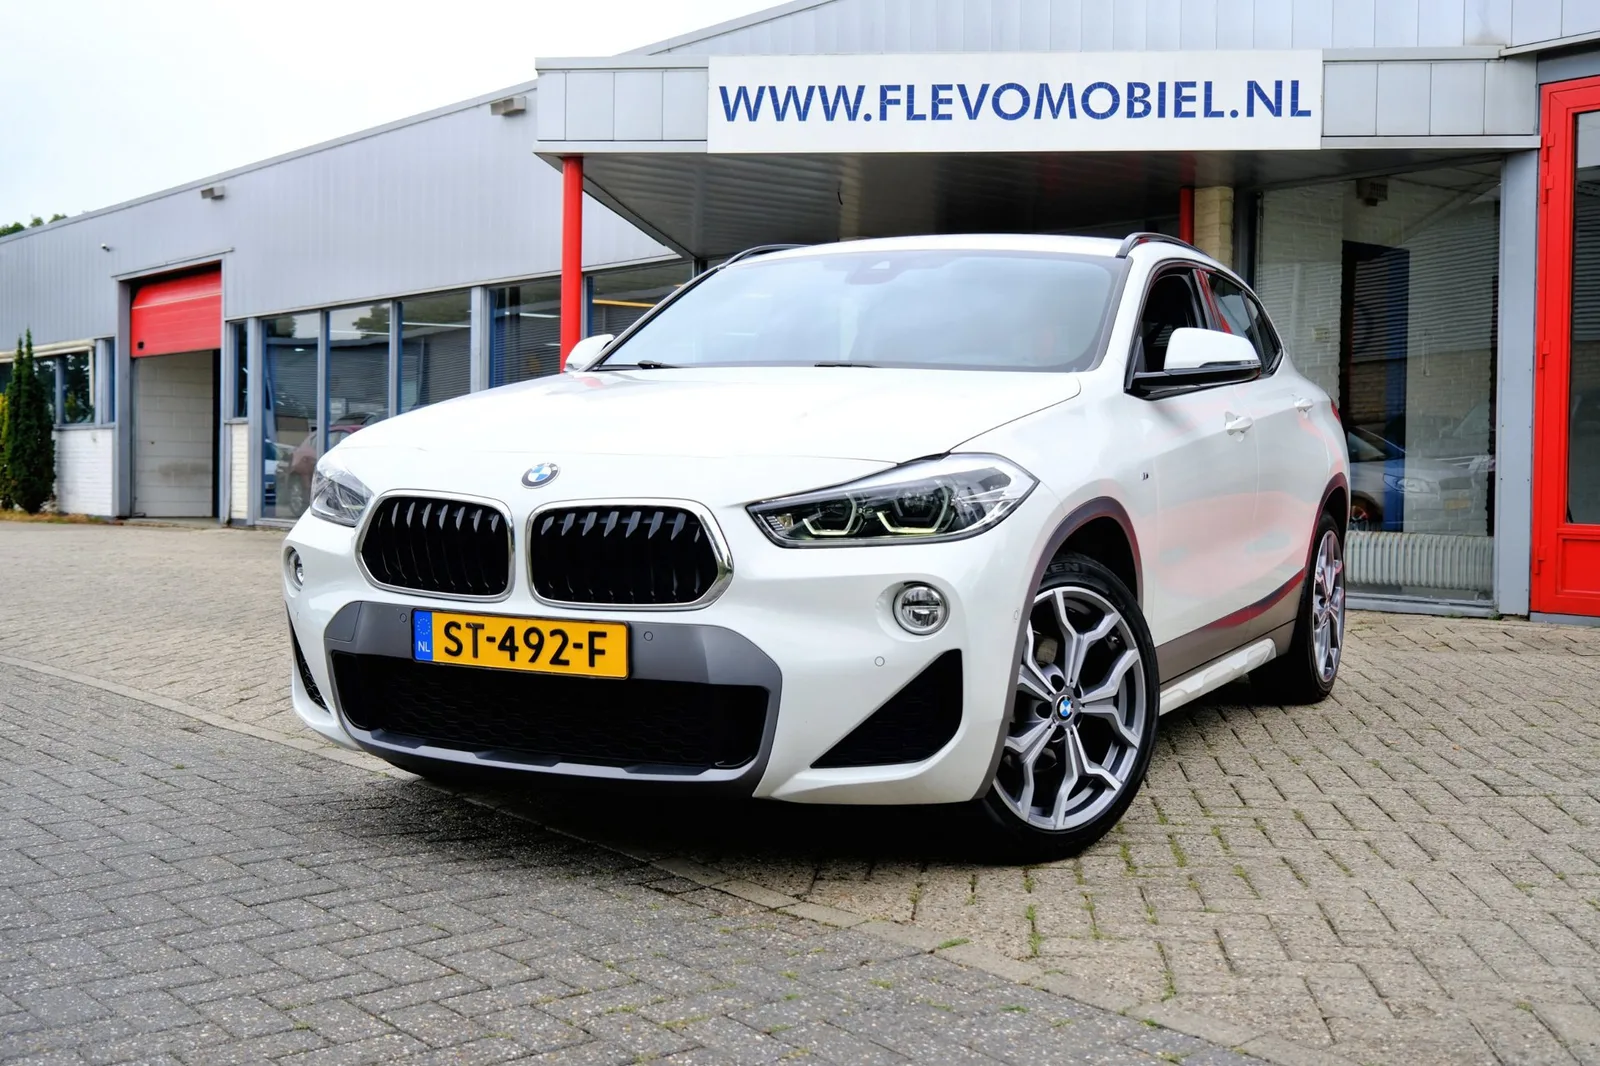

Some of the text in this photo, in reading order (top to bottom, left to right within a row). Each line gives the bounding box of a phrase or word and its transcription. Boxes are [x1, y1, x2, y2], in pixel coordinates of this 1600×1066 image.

[718, 79, 1312, 122] WWW.FLEVOMOBIEL.NL
[417, 640, 431, 653] NL
[443, 620, 607, 668] ST-492-F
